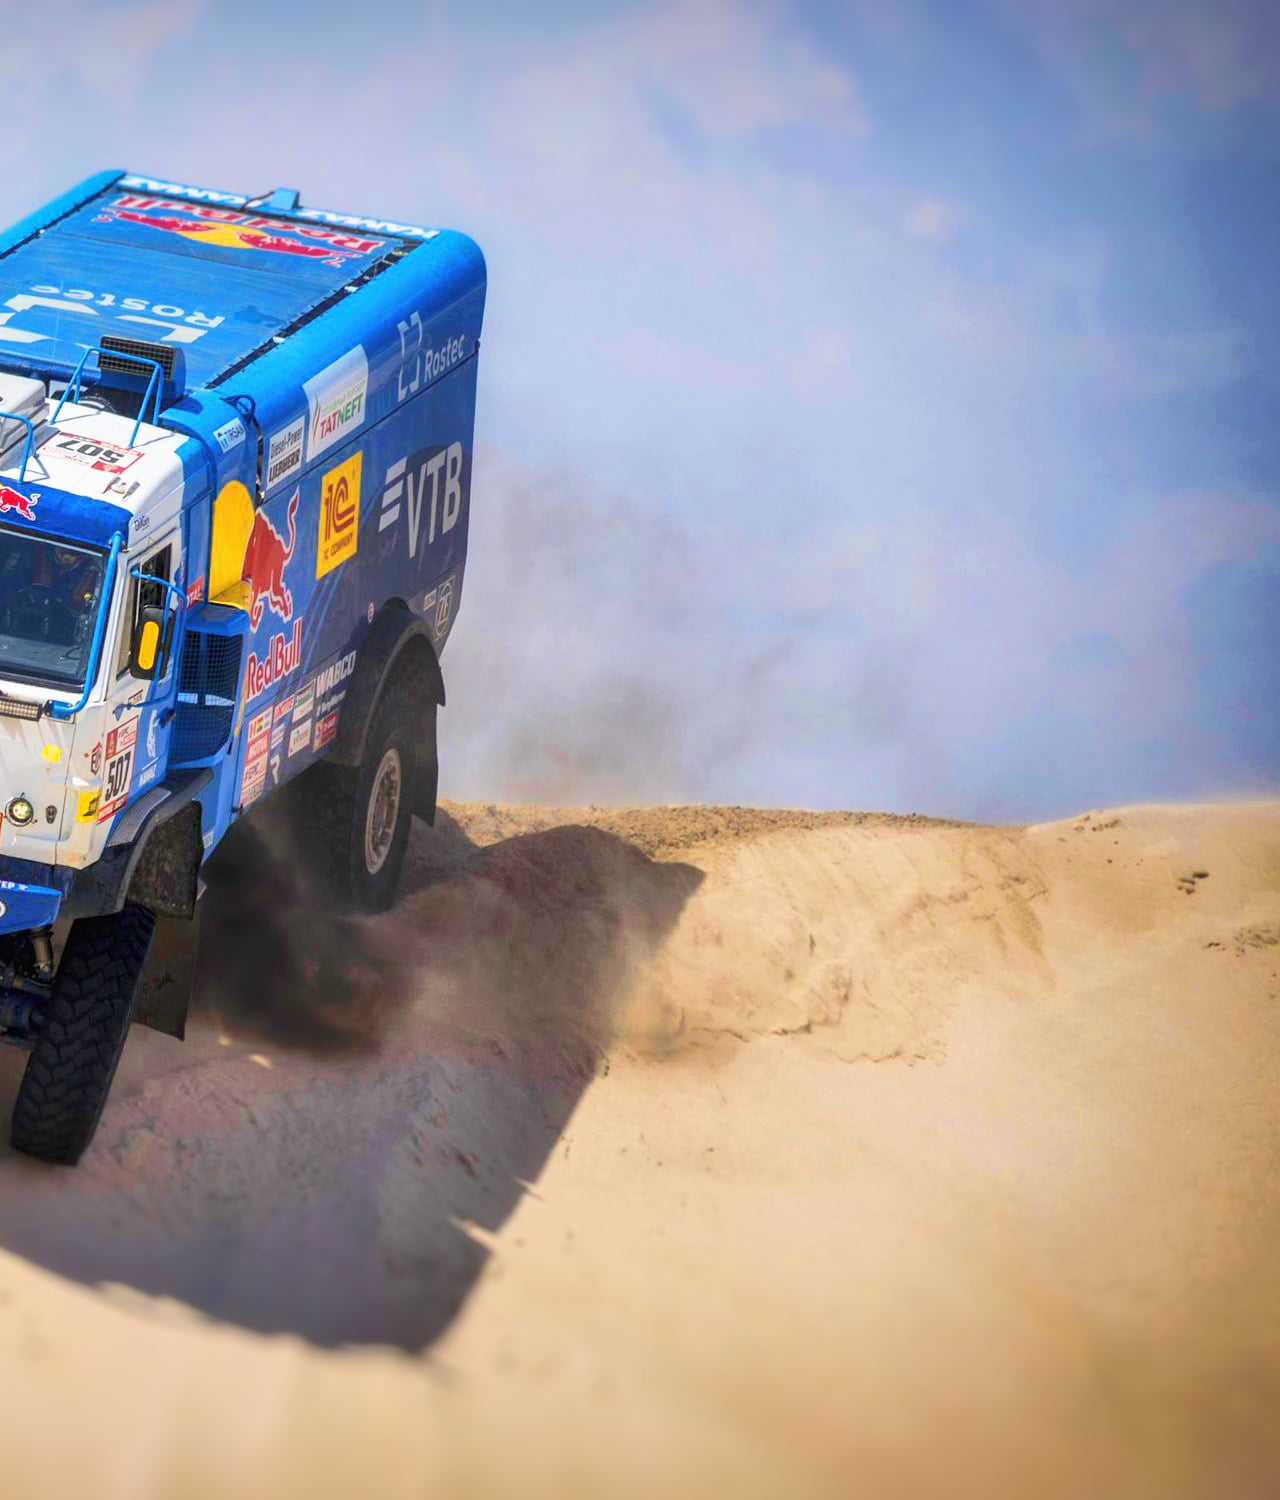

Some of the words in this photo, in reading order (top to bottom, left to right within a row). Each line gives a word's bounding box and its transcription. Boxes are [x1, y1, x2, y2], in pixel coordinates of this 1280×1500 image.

[29, 285, 226, 328] Rostec
[424, 334, 465, 383] Rostec
[320, 394, 363, 440] TATNEFT
[56, 440, 125, 464] 507
[407, 441, 463, 559] VTB
[246, 635, 274, 703] Red
[273, 617, 303, 682] Bull
[316, 650, 357, 698] WABCO
[105, 750, 132, 802] 507
